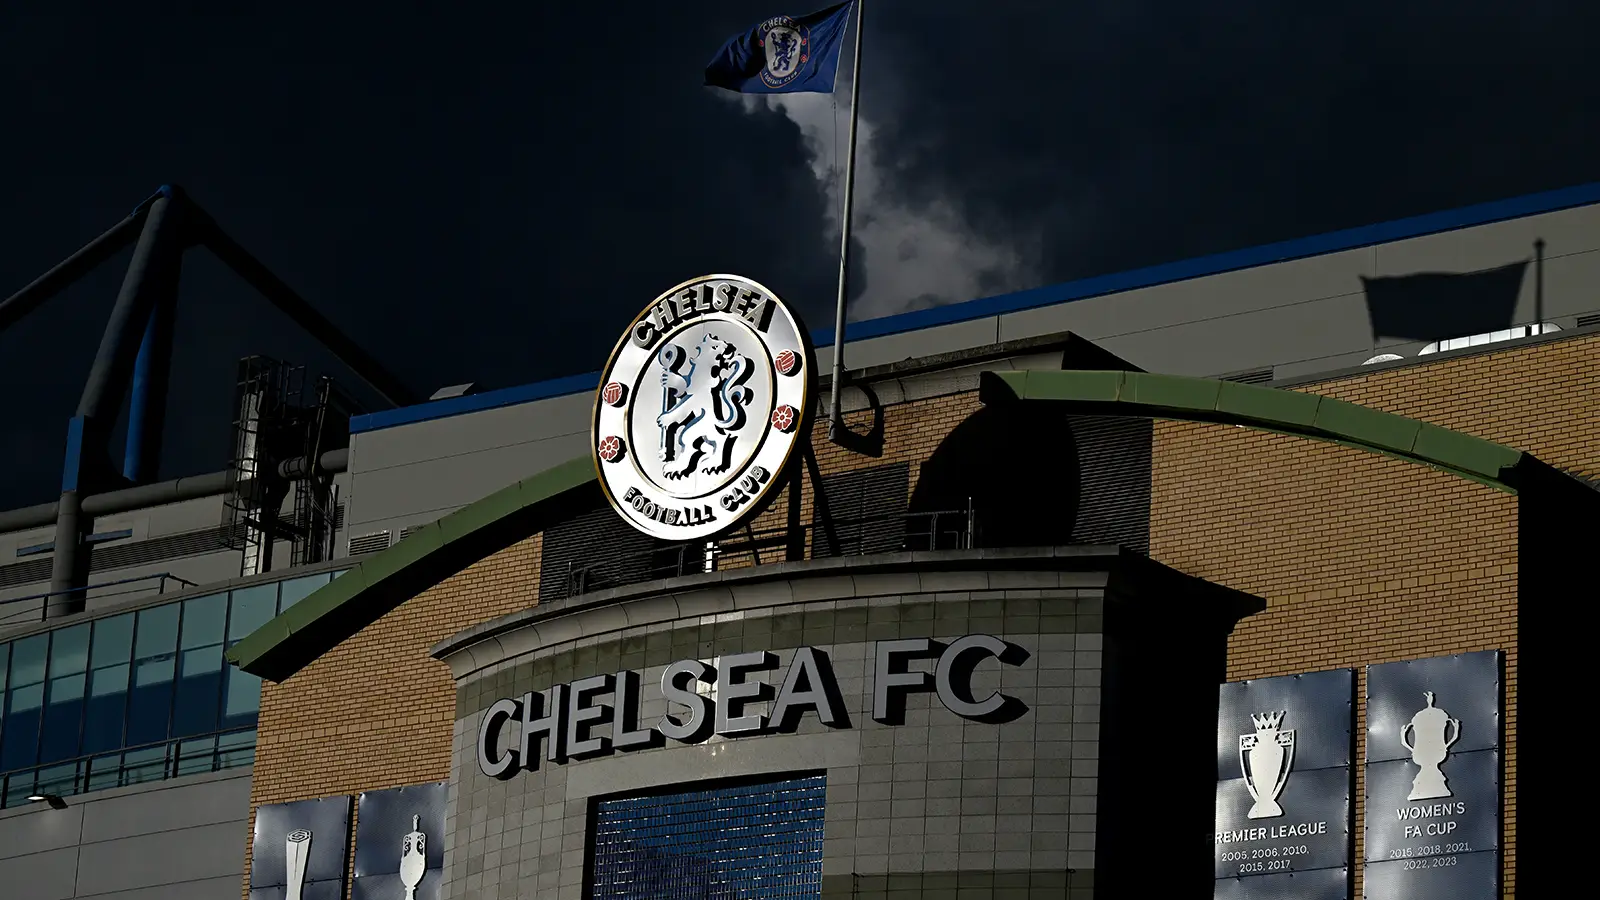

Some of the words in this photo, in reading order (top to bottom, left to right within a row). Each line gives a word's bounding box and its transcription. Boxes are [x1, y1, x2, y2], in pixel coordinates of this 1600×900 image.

[631, 283, 774, 349] CHELSEA
[623, 487, 714, 525] FOOTBALL
[720, 466, 767, 510] CLUB
[478, 646, 845, 778] CHELSEA
[873, 633, 1022, 724] FC
[1396, 802, 1466, 820] WOMEN'S
[1271, 821, 1327, 839] LEAGUE
[1404, 826, 1422, 838] FA
[1427, 821, 1457, 836] CUP
[1268, 859, 1291, 870] 2017
[1433, 856, 1457, 868] 2023
